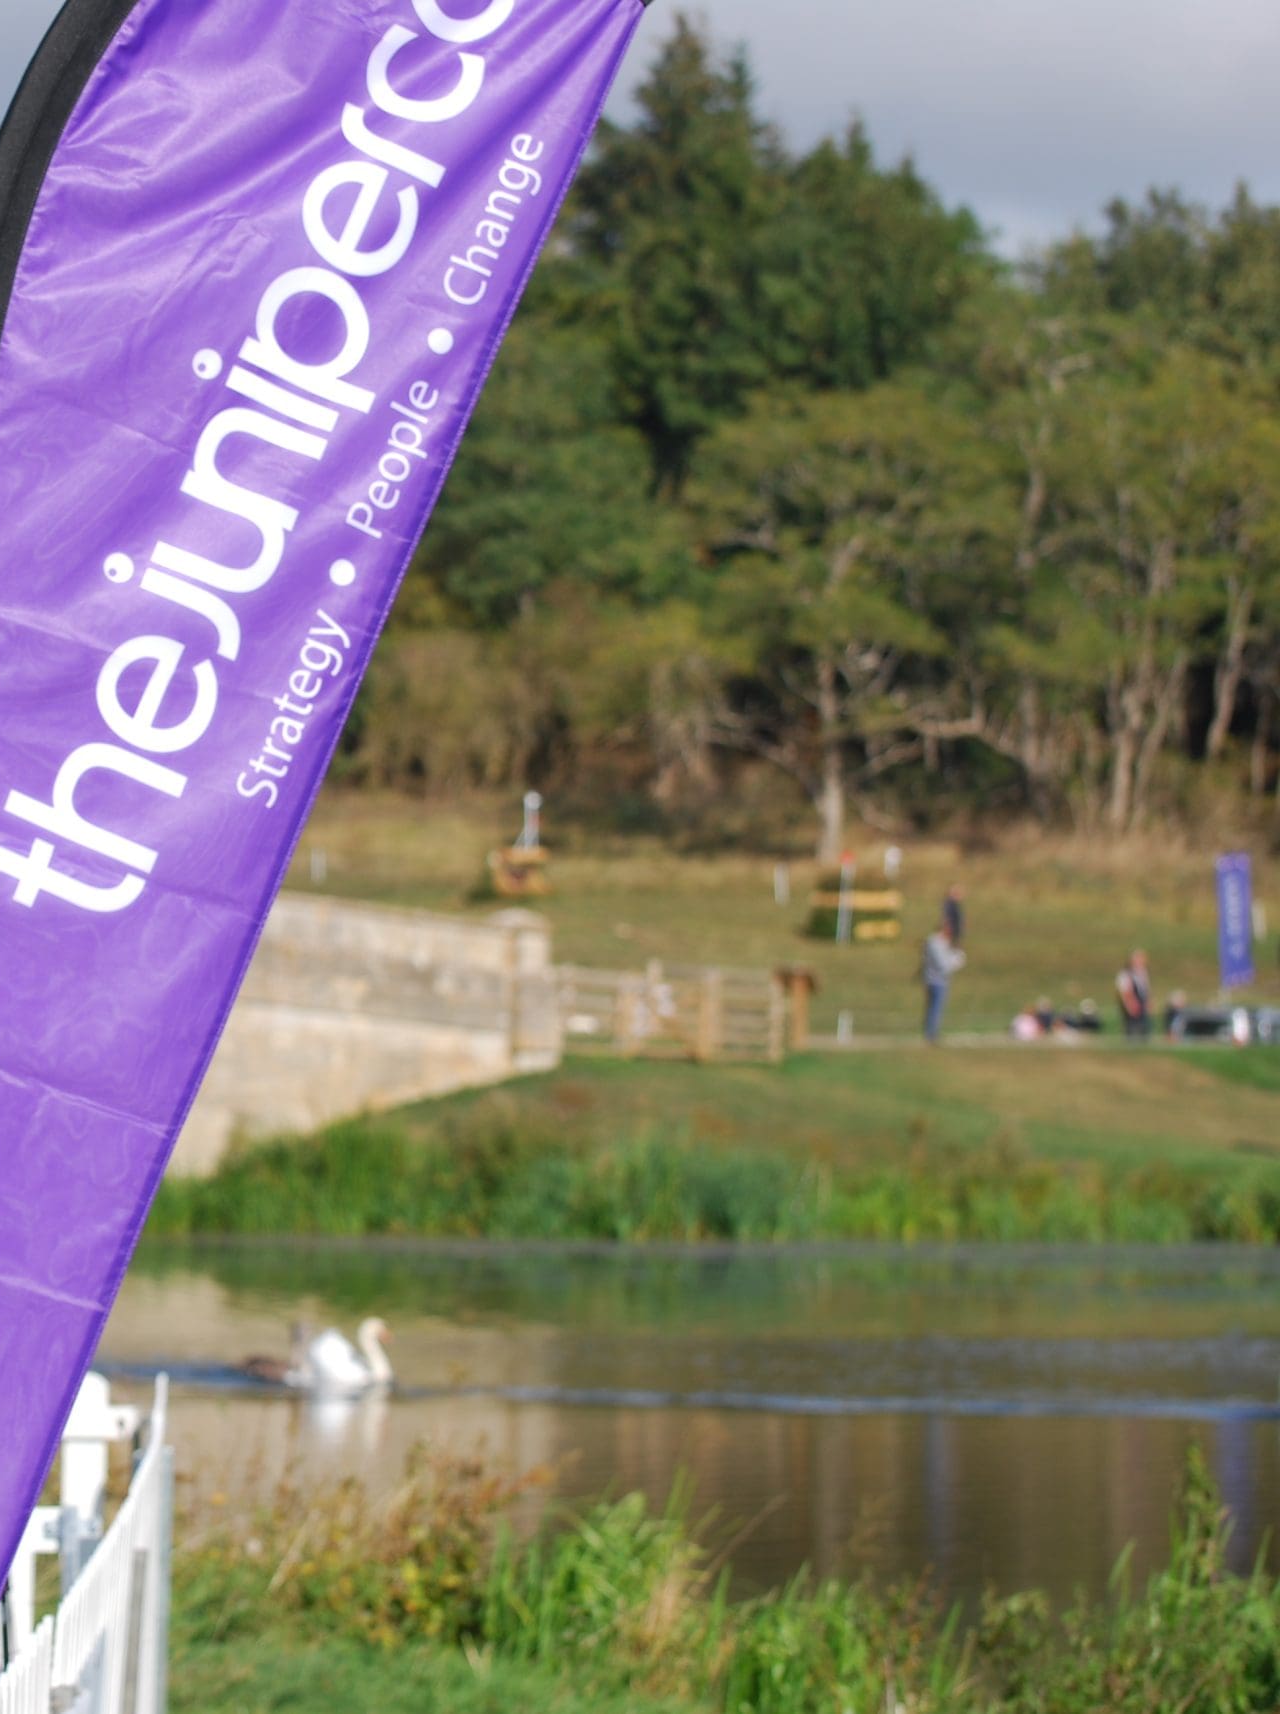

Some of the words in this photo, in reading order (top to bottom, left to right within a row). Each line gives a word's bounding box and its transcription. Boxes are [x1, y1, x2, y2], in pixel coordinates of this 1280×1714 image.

[236, 608, 352, 809] Strategy
[345, 378, 440, 539] People
[442, 132, 545, 307] Change
